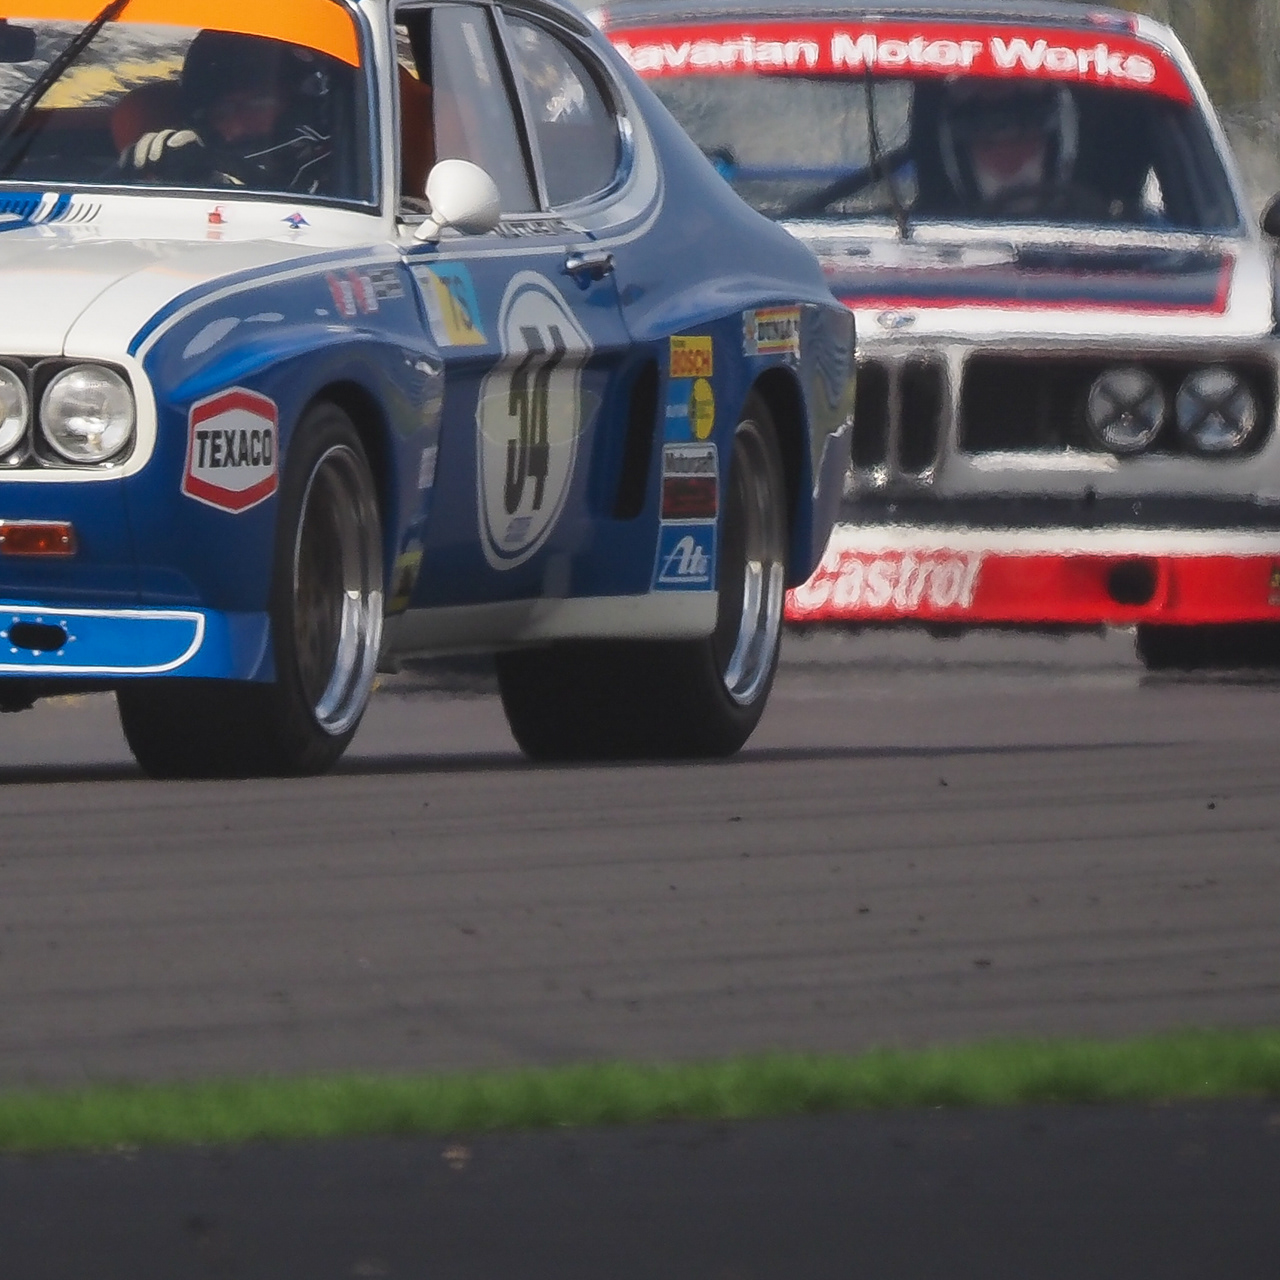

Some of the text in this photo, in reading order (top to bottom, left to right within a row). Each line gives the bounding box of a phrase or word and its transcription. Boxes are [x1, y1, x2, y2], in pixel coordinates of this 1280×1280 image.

[831, 32, 982, 68] Motor
[991, 37, 1156, 83] Works
[196, 429, 272, 468] TEXACO
[796, 548, 987, 609] Castrol
